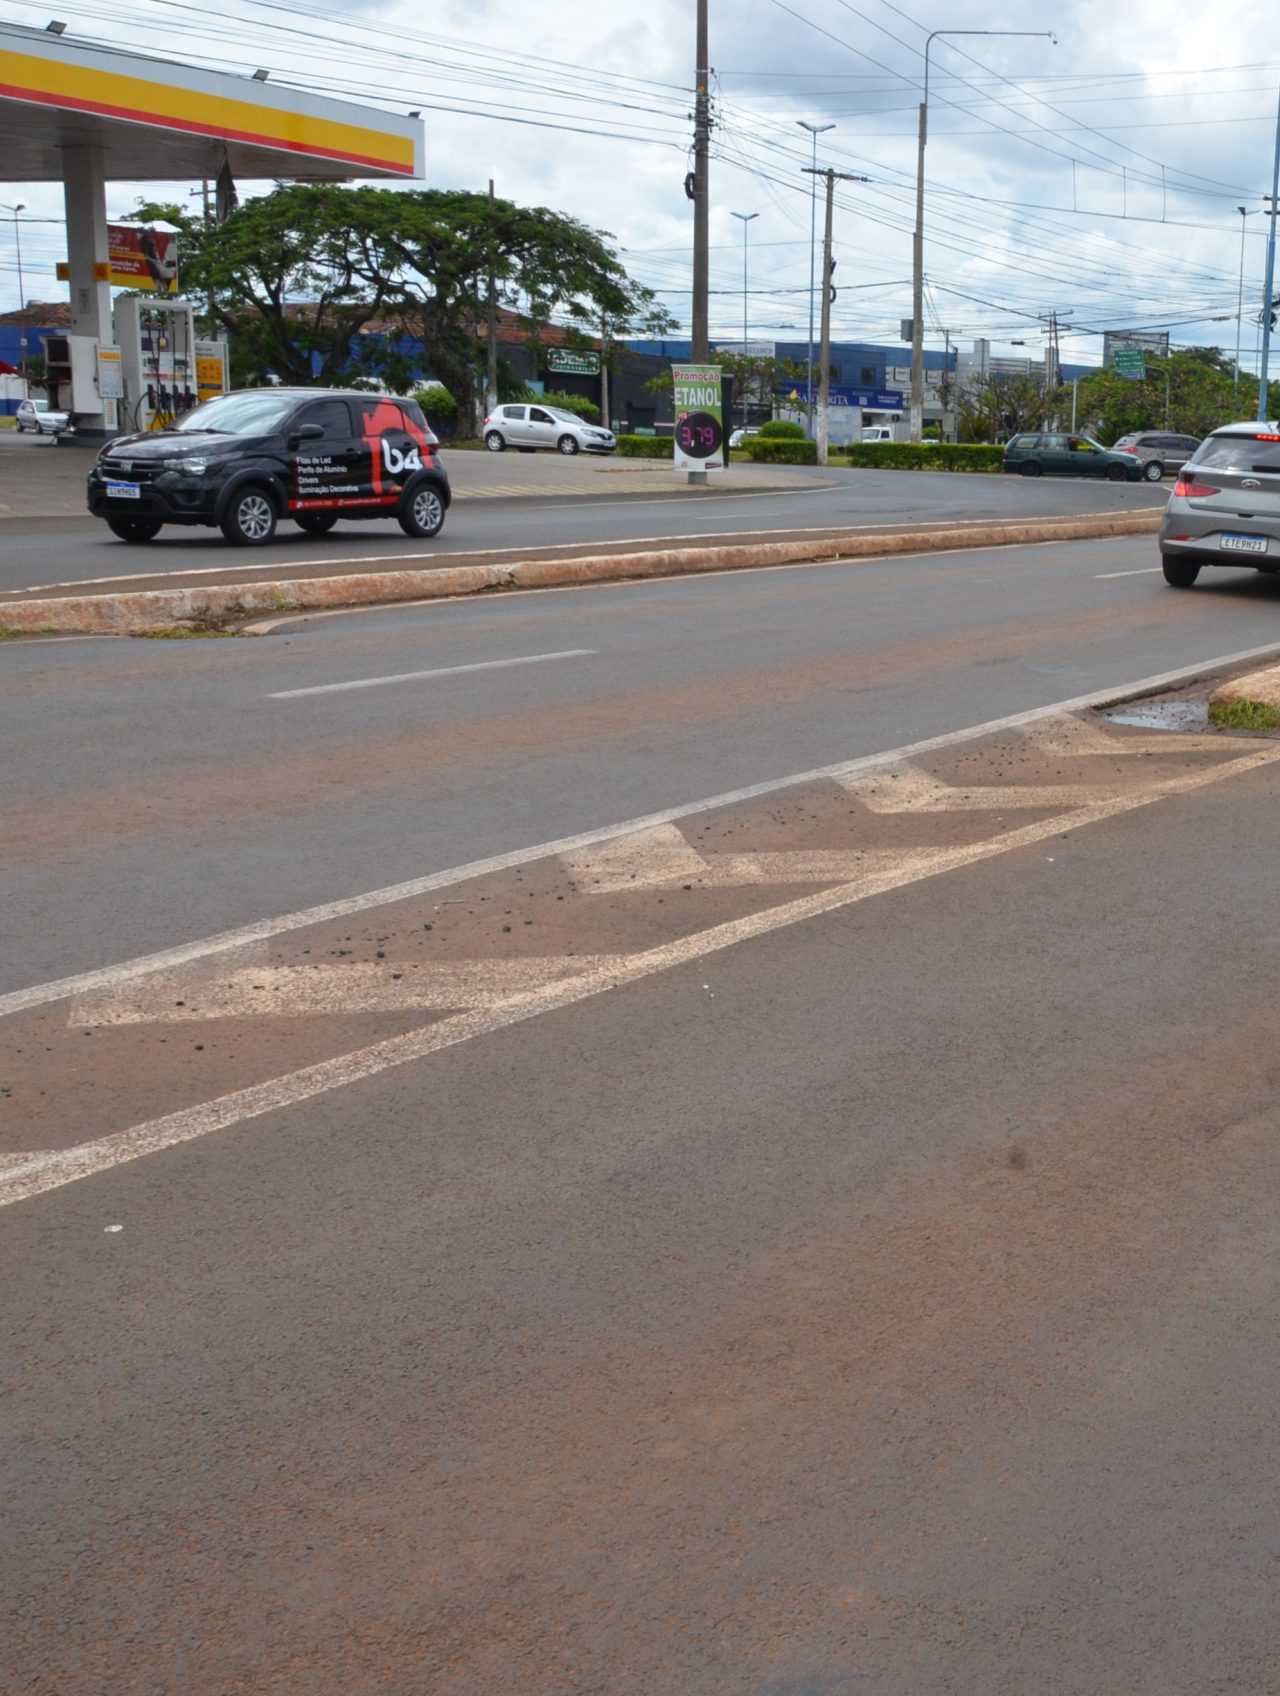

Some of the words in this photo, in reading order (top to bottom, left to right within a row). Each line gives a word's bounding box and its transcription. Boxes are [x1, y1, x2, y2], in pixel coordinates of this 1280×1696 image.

[674, 370, 720, 382] Promoção
[674, 387, 722, 407] ETANOL
[682, 427, 714, 448] 3,79
[315, 466, 323, 474] de
